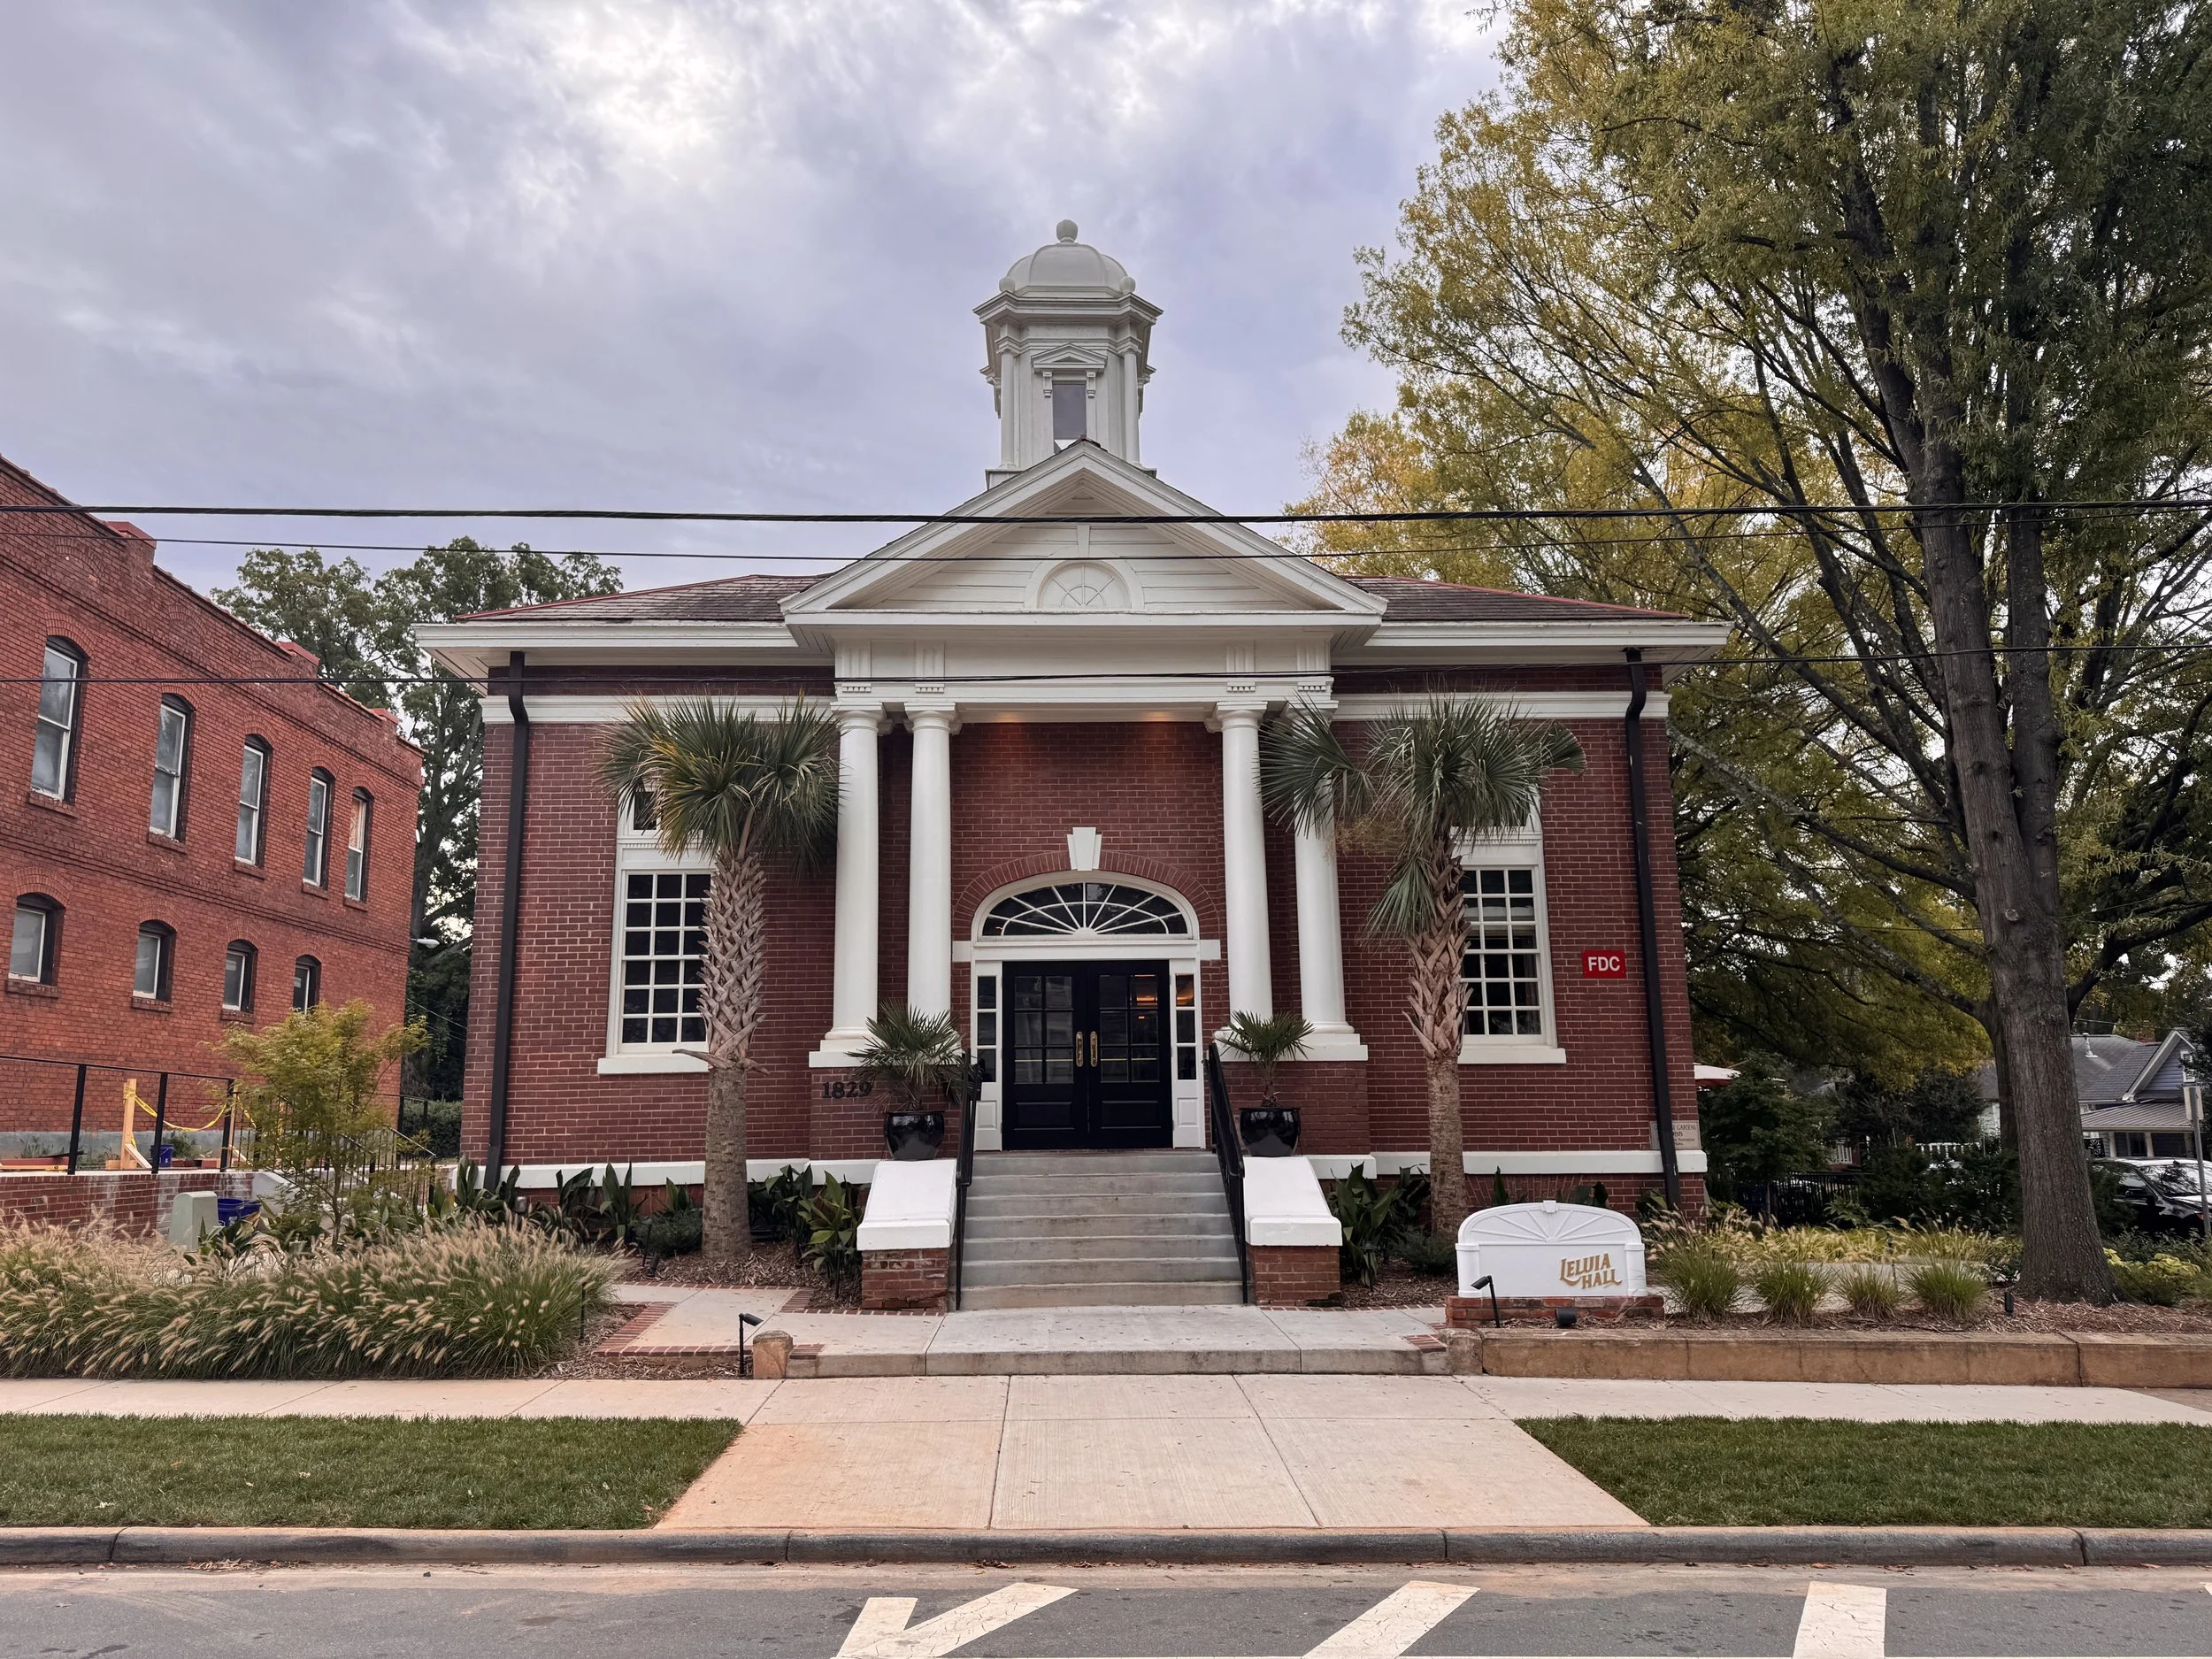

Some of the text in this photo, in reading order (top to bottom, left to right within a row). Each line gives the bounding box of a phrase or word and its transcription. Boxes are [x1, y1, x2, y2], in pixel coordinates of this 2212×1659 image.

[1588, 956, 1620, 972] FDC
[823, 1081, 872, 1098] 1829
[1560, 1253, 1610, 1286] LELUIA
[1582, 1269, 1622, 1289] HALL
